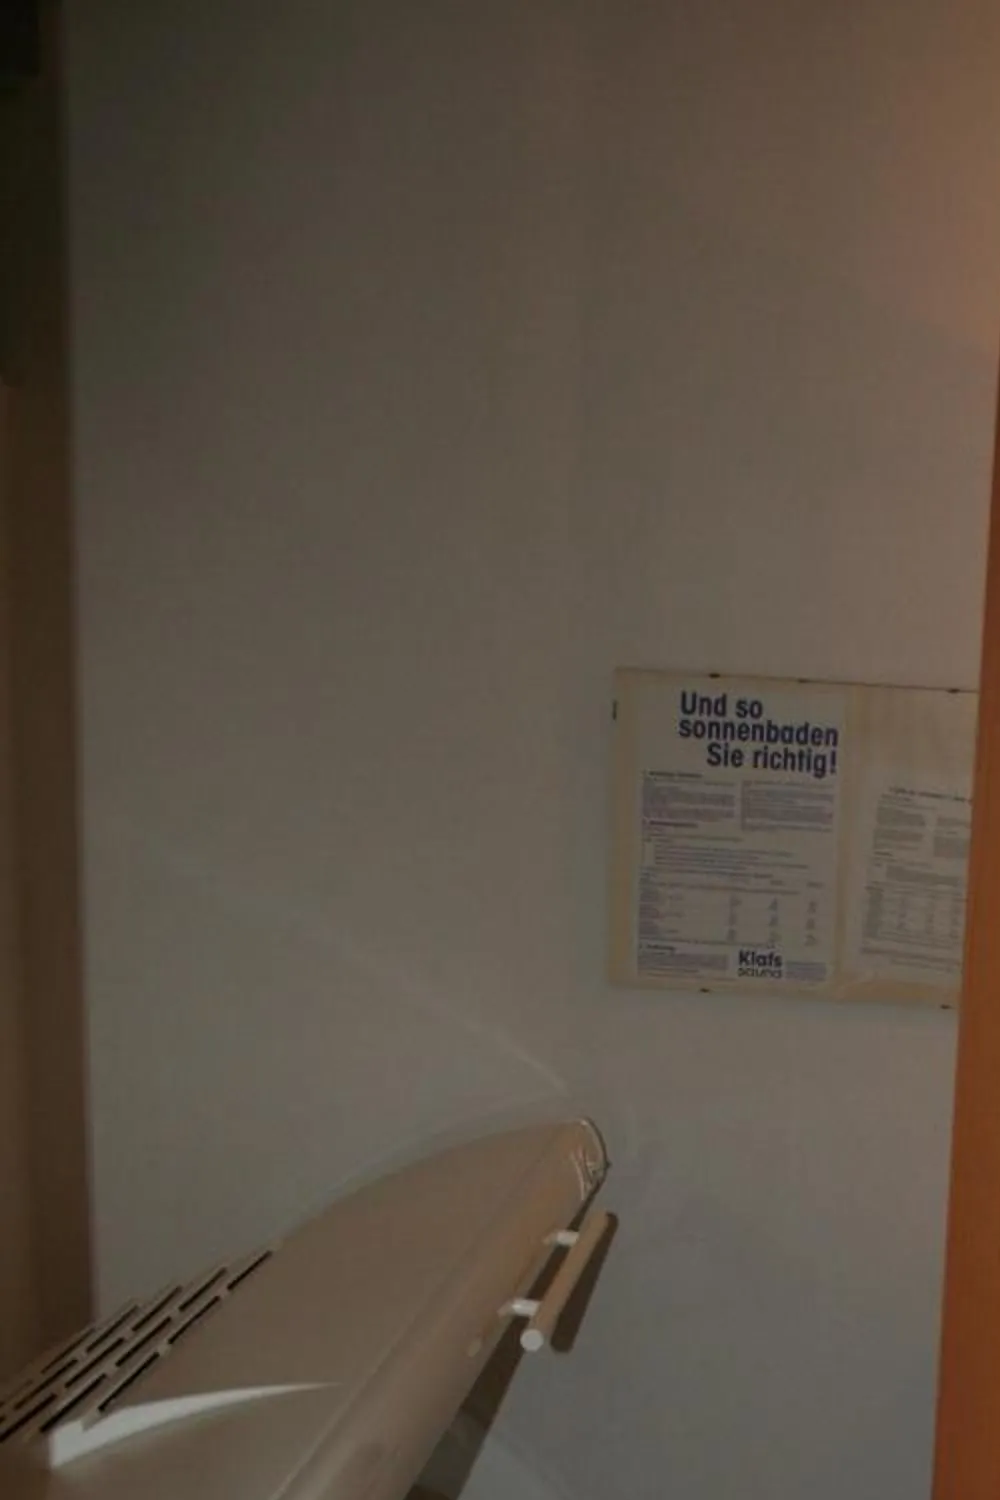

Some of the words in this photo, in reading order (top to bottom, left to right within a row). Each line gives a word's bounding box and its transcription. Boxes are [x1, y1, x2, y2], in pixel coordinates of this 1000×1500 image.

[680, 690, 727, 718] Und
[735, 699, 764, 720] so
[678, 717, 839, 747] sonnenbaden
[706, 742, 744, 768] Sie
[752, 746, 837, 779] richtig!
[738, 950, 783, 968] Klafs
